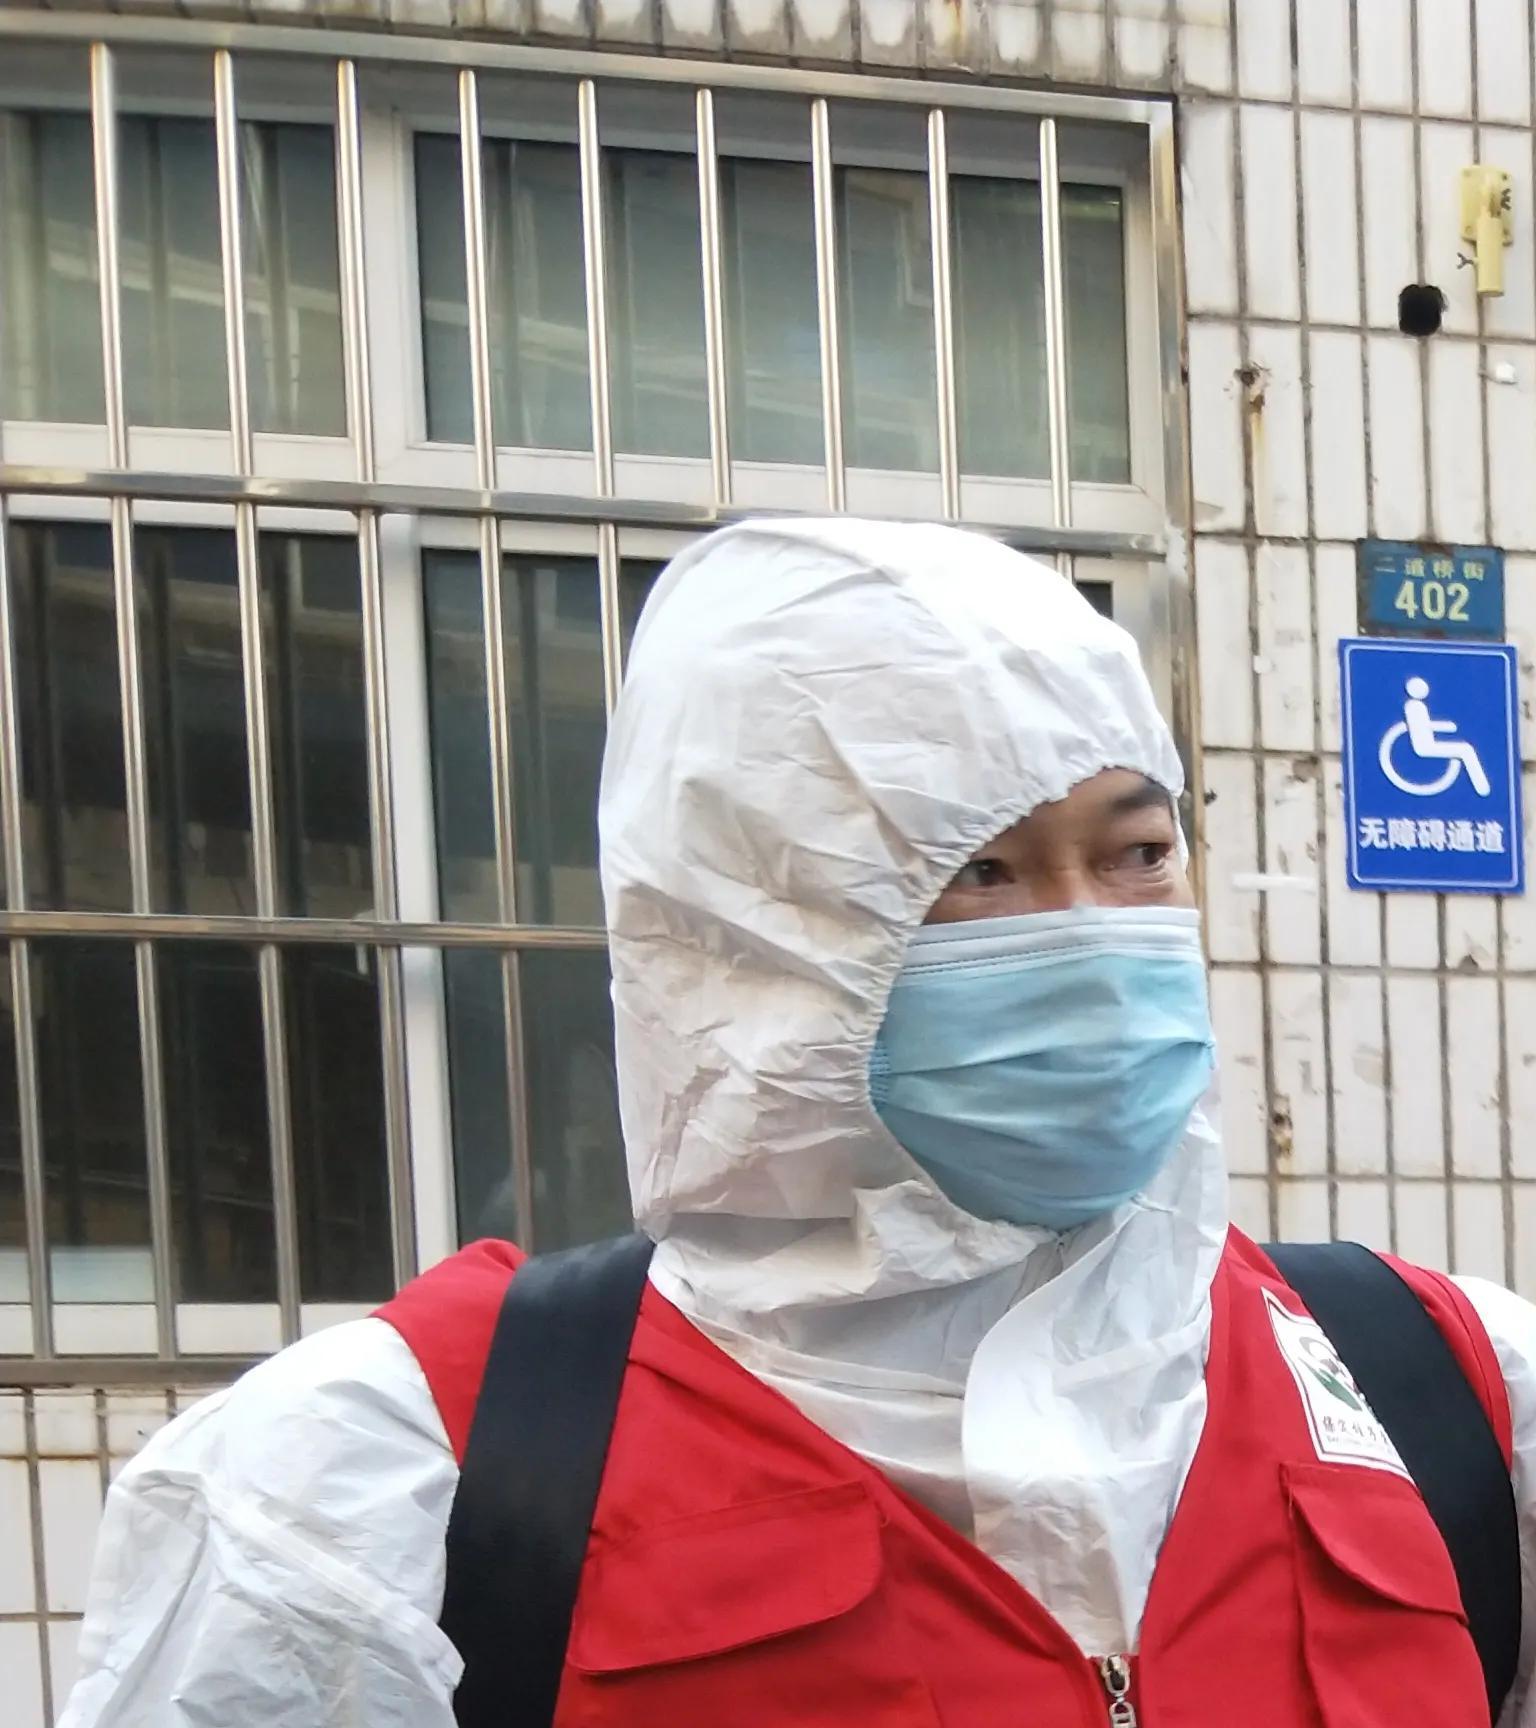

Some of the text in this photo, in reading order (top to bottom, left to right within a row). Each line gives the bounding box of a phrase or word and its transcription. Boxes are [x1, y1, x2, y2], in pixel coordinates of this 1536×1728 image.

[1375, 557, 1485, 581] 二道桥街
[1394, 580, 1470, 621] 402
[1359, 817, 1505, 853] 无障碍通道
